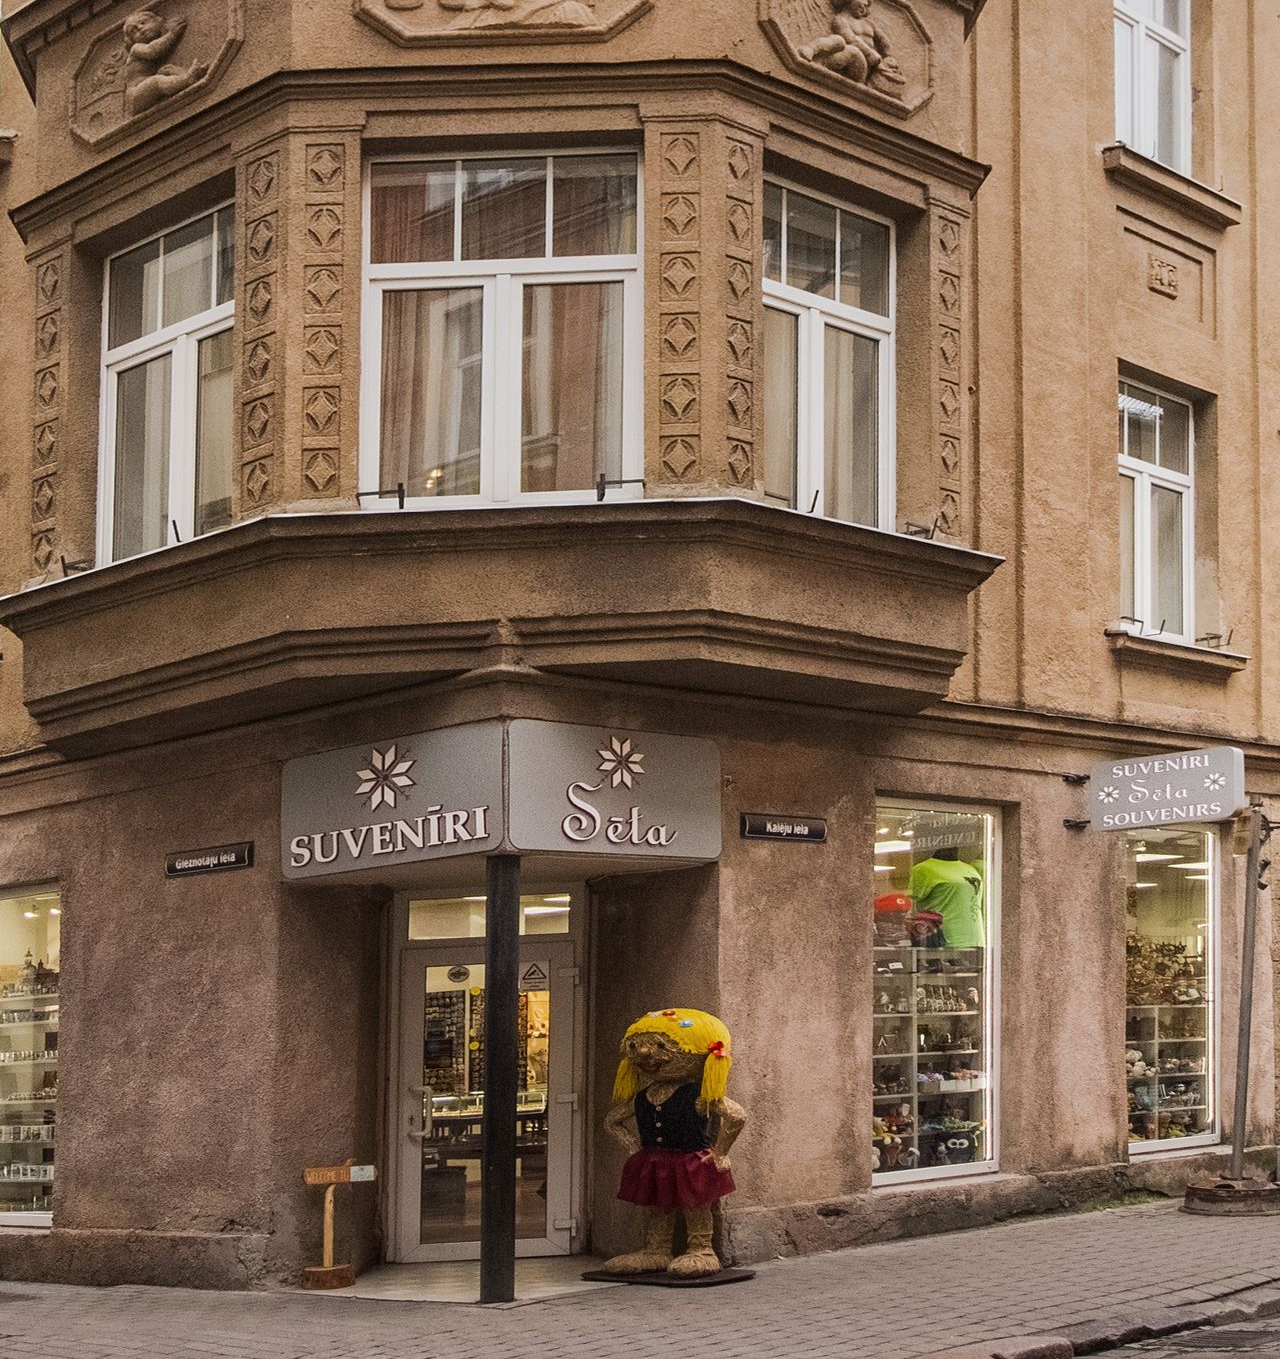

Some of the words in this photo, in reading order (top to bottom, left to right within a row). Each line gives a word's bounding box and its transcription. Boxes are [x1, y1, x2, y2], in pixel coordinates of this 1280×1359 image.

[1112, 754, 1210, 779] SUVENĪRI
[561, 782, 677, 847] Sēta
[1103, 802, 1222, 827] SOUVENIRS
[290, 804, 489, 868] SUVENĪRI
[793, 824, 809, 835] iela
[220, 851, 236, 863] iela
